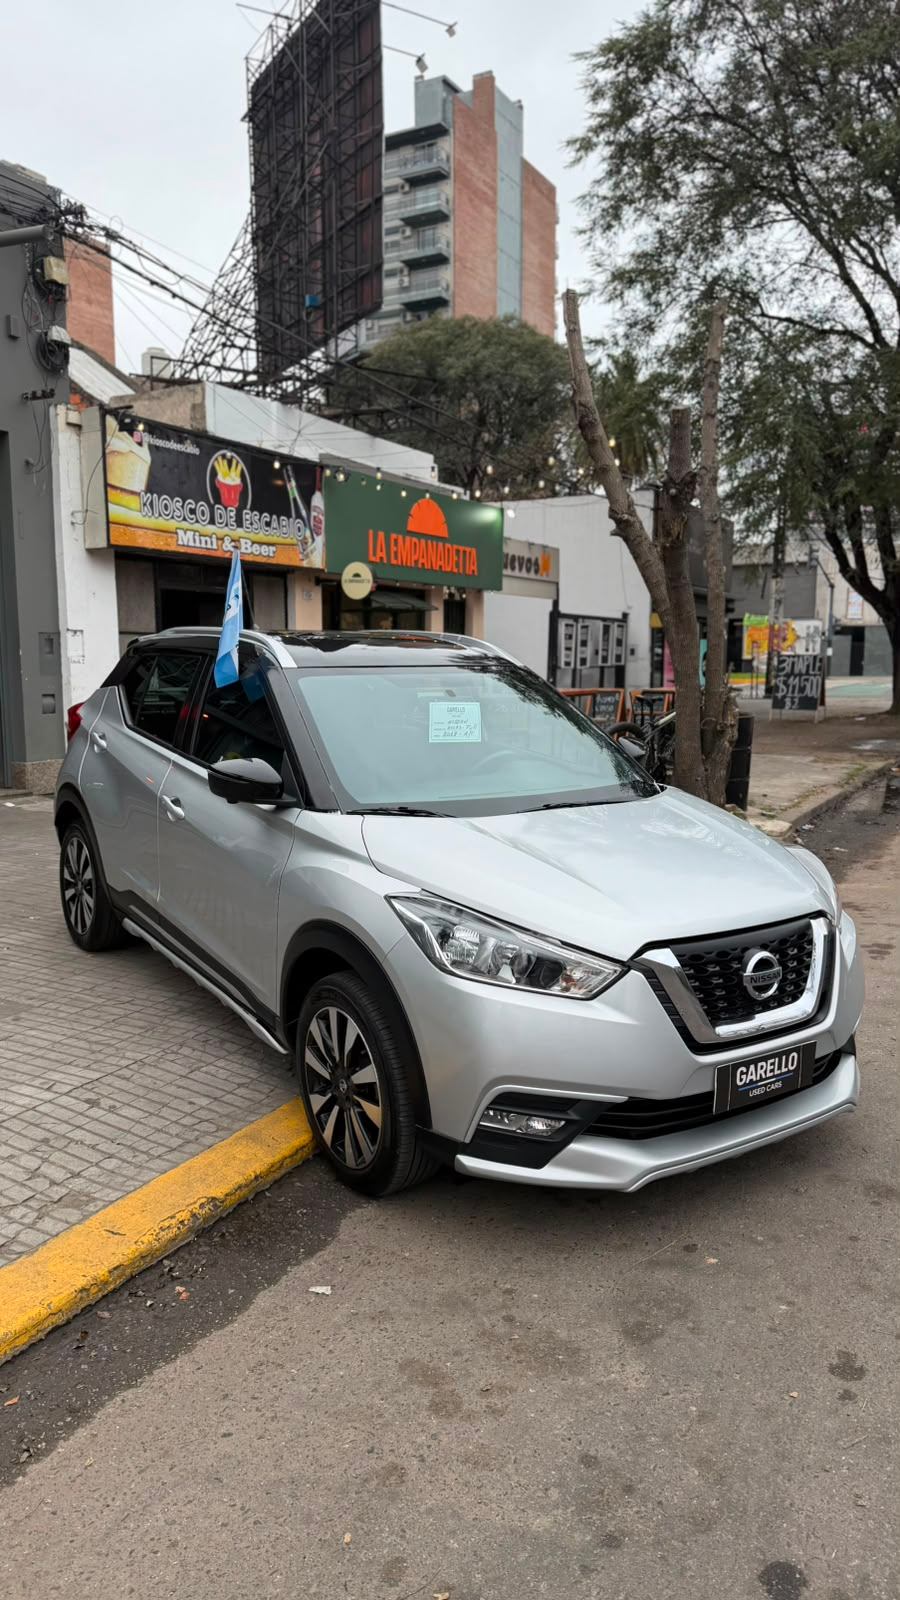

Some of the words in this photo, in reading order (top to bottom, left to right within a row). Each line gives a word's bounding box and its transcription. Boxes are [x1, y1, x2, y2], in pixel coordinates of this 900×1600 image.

[140, 492, 210, 525] KIOSCO
[214, 504, 237, 529] DE
[242, 509, 305, 540] ESCABIO
[176, 528, 218, 551] Mini
[222, 536, 237, 553] &
[239, 538, 276, 557] Beer
[368, 529, 387, 563] LA
[390, 534, 478, 576] EMPANADETTA
[750, 971, 781, 984] NISSAN
[736, 1052, 798, 1085] GARELLO
[749, 1086, 766, 1097] USED
[766, 1081, 782, 1092] CARS
